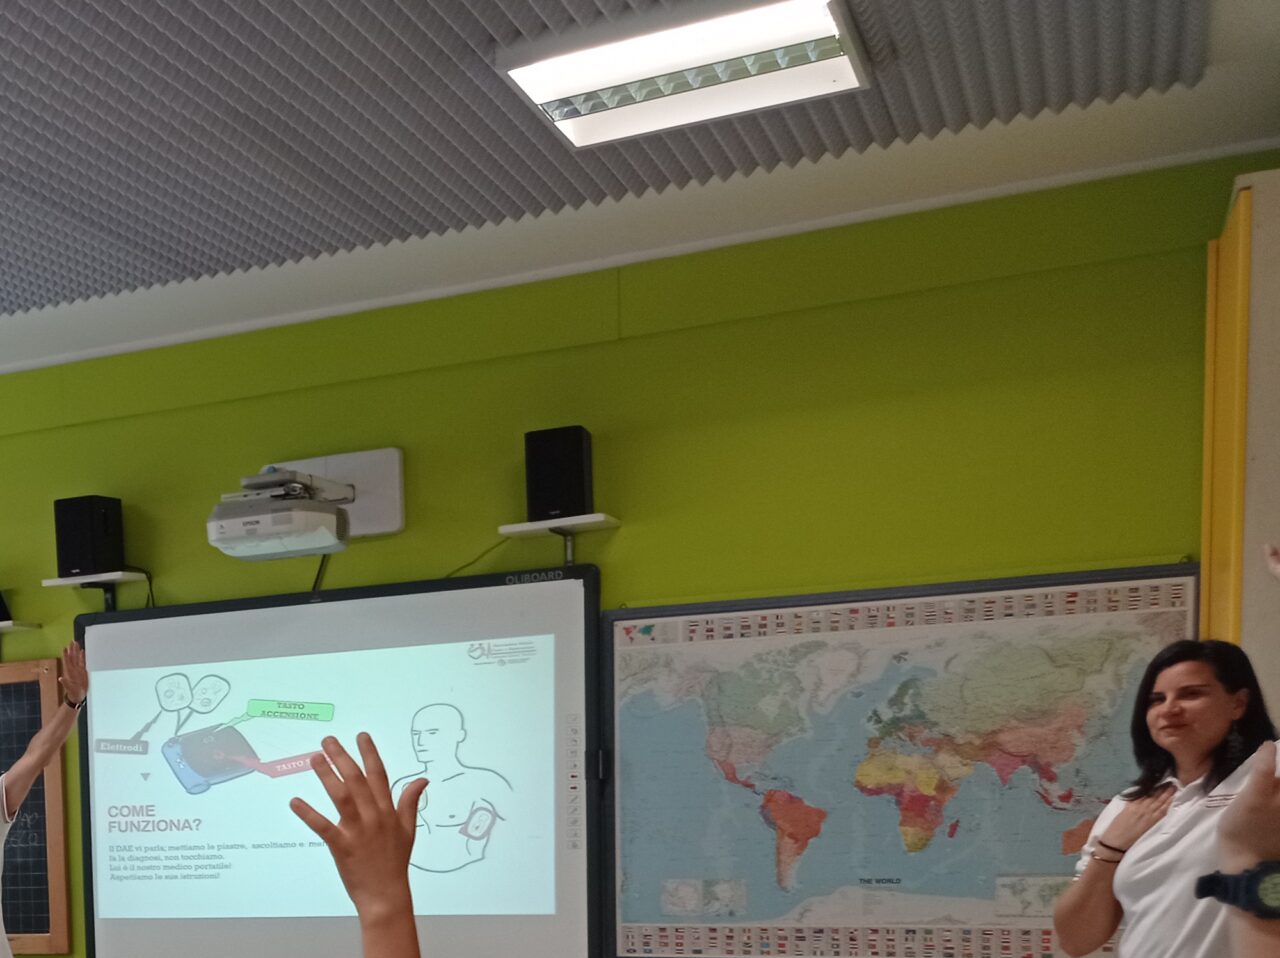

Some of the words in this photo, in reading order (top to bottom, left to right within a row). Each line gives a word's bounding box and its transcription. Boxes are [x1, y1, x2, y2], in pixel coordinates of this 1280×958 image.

[277, 702, 305, 710] TASTO
[260, 710, 320, 721] ACCENSIONE
[99, 742, 144, 752] Elettrodi
[275, 760, 304, 771] TASTO
[108, 805, 156, 817] COME
[108, 818, 202, 833] FUNZIONA?
[252, 841, 297, 849] ascoltiamo
[110, 873, 153, 881] Aspettiamo
